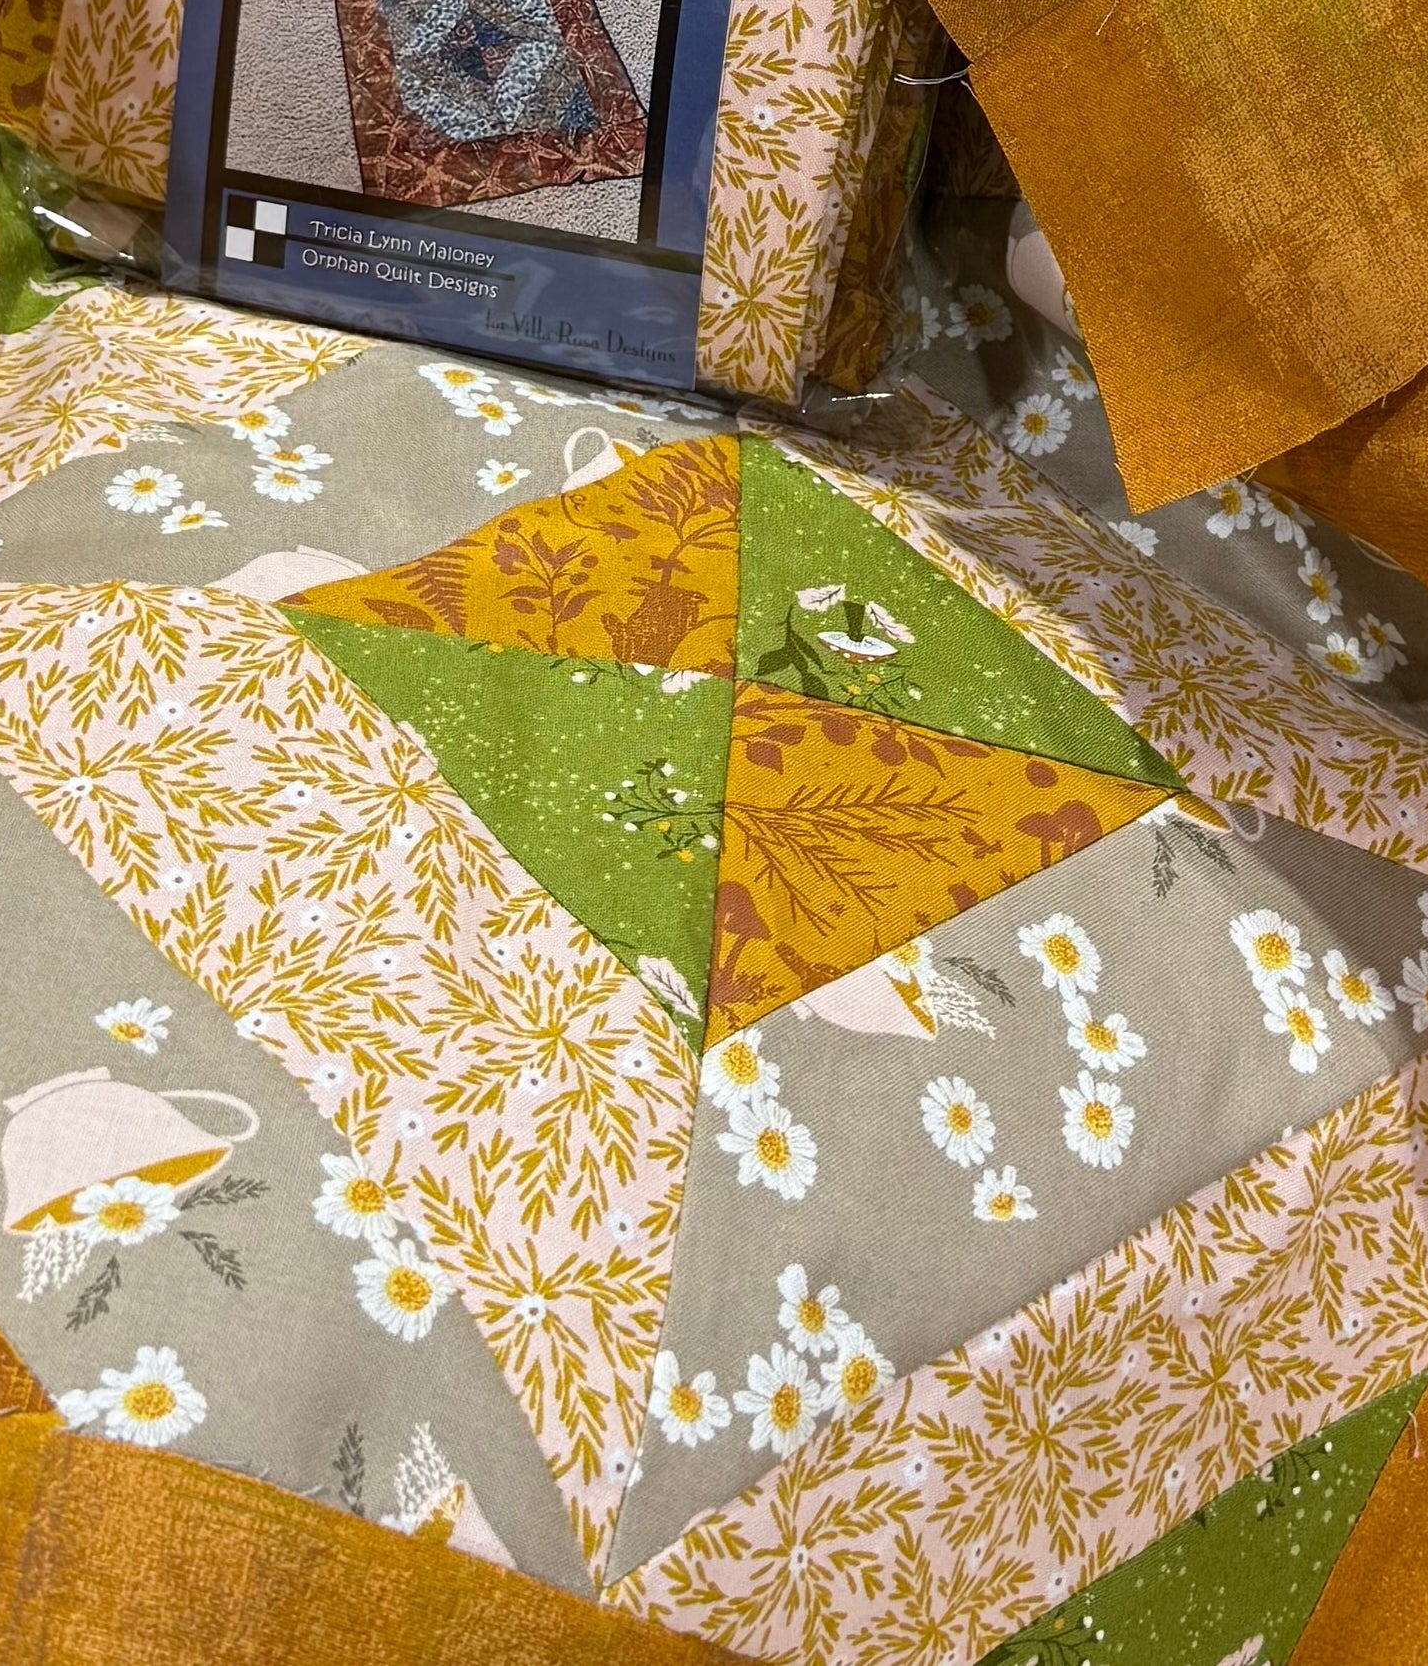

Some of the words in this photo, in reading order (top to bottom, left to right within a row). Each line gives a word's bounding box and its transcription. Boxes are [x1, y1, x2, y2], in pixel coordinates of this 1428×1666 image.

[309, 219, 363, 245] Tricia
[368, 230, 412, 253] Lynn
[418, 239, 495, 269] Maloney
[302, 248, 370, 275] Orphan
[375, 262, 422, 284] Quilt
[428, 271, 499, 299] Designs
[512, 311, 554, 342] Villa
[557, 319, 600, 350] Rosa
[606, 329, 677, 364] Designs
